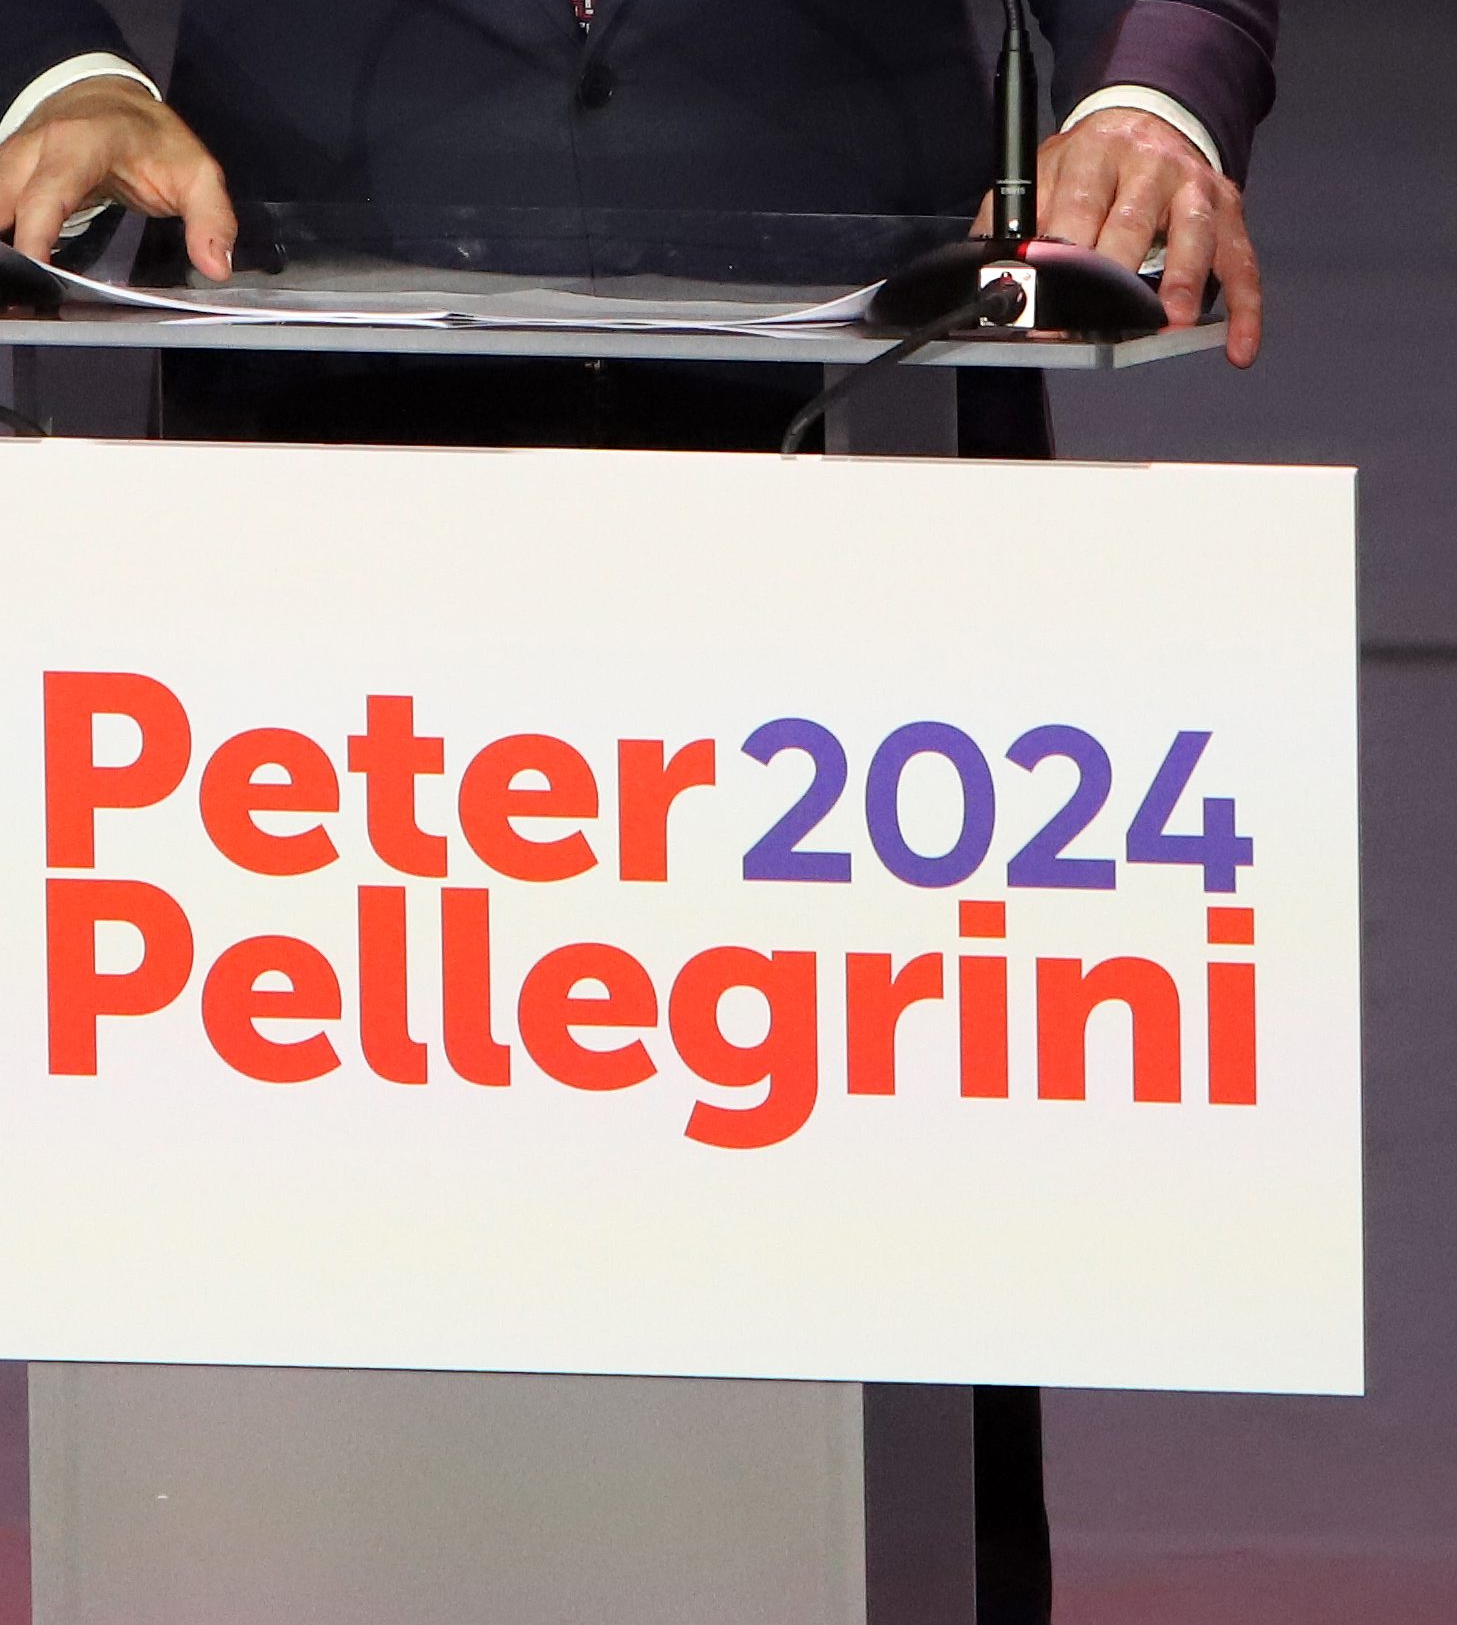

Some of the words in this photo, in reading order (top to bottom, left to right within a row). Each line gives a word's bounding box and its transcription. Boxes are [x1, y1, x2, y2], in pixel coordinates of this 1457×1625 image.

[43, 670, 716, 884] Peter
[743, 718, 1253, 893] 2024
[45, 878, 1258, 1150] Pellegrini
